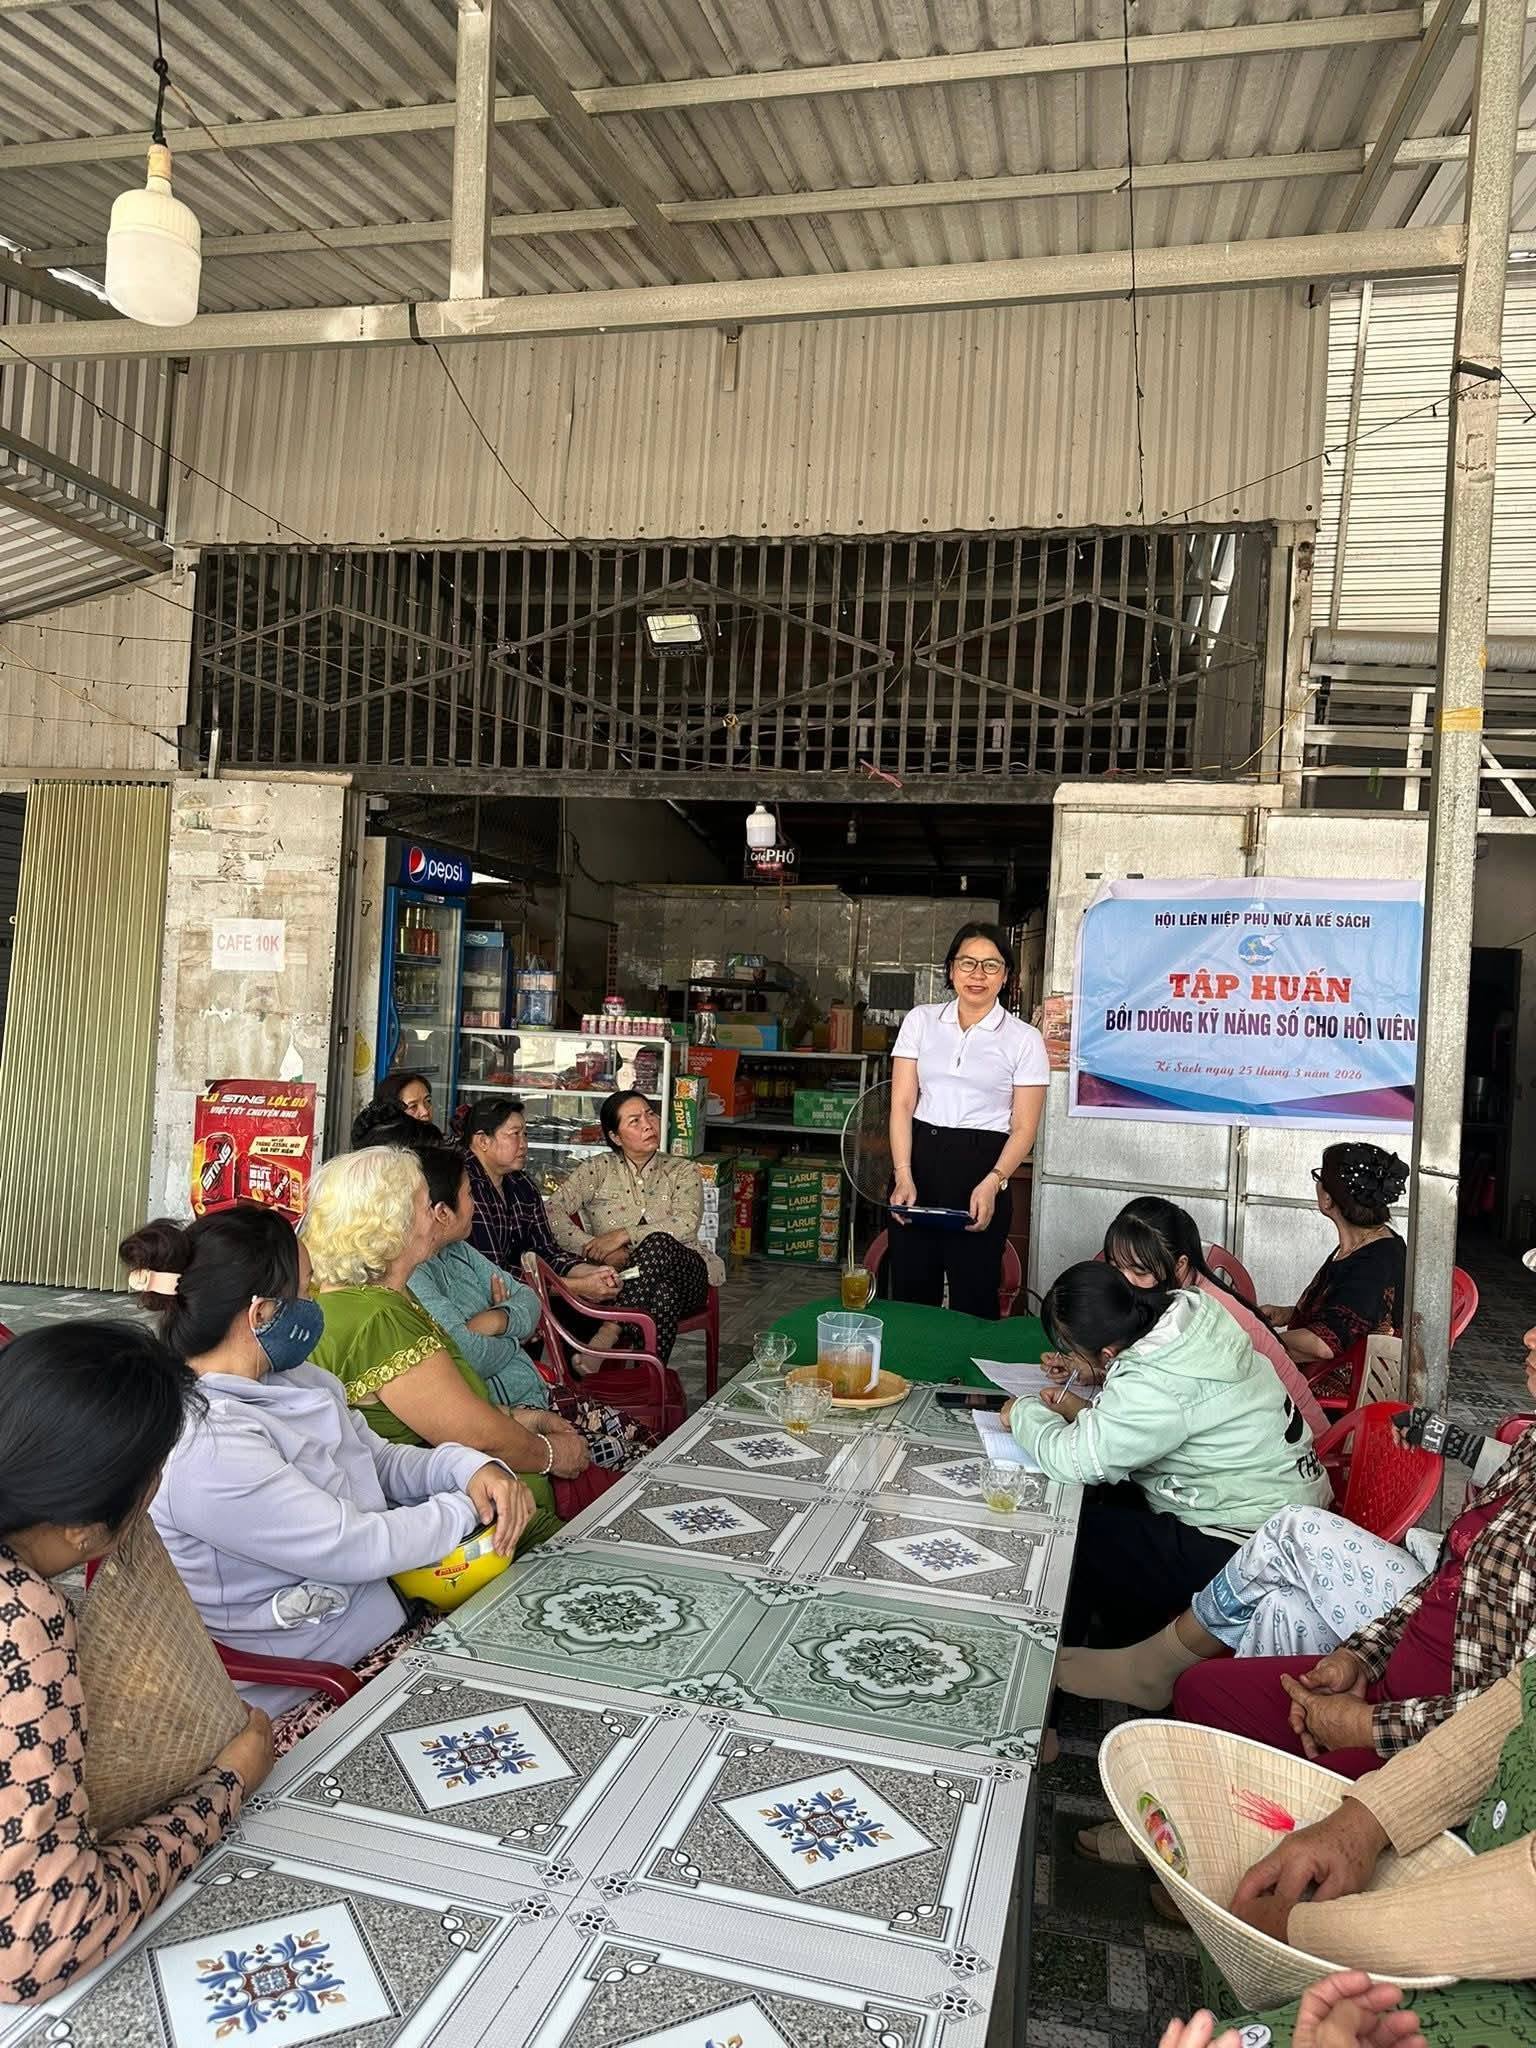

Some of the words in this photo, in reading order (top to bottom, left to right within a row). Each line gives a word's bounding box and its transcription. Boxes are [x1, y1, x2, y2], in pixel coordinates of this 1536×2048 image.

[428, 859, 463, 884] pepsi
[1154, 912, 1176, 928] HỘI
[1180, 912, 1208, 926] LIÊN
[1211, 911, 1240, 928] HIỆP
[1244, 913, 1270, 928] PHỤ
[1274, 911, 1293, 926] NỮ
[1295, 912, 1312, 927] XÃ
[1316, 911, 1333, 927] KẾ
[1336, 912, 1371, 928] SÁCH
[217, 934, 252, 951] CAFE
[256, 935, 280, 952] 10K
[1169, 968, 1240, 1005] TẬP
[1251, 968, 1352, 1003] HUẤN
[1105, 1002, 1132, 1031] BỒI
[1137, 1006, 1193, 1033] DƯỠNG
[1198, 1008, 1220, 1034] KỸ
[1224, 1008, 1271, 1035] NĂNG
[1276, 1007, 1300, 1036] SỐ
[1304, 1015, 1338, 1038] CHO
[1343, 1012, 1372, 1044] HỘI
[1377, 1013, 1416, 1041] VIÊN
[1239, 1065, 1254, 1076] 25
[1295, 1068, 1301, 1078] 3
[1334, 1069, 1362, 1080] 2026
[221, 1094, 266, 1105] STING
[673, 1100, 688, 1137] LARUE
[201, 1143, 232, 1192] STING
[789, 1172, 818, 1184] LARUE
[788, 1194, 818, 1206] LARUE
[787, 1217, 817, 1229] LARUE
[785, 1240, 815, 1251] LARUE
